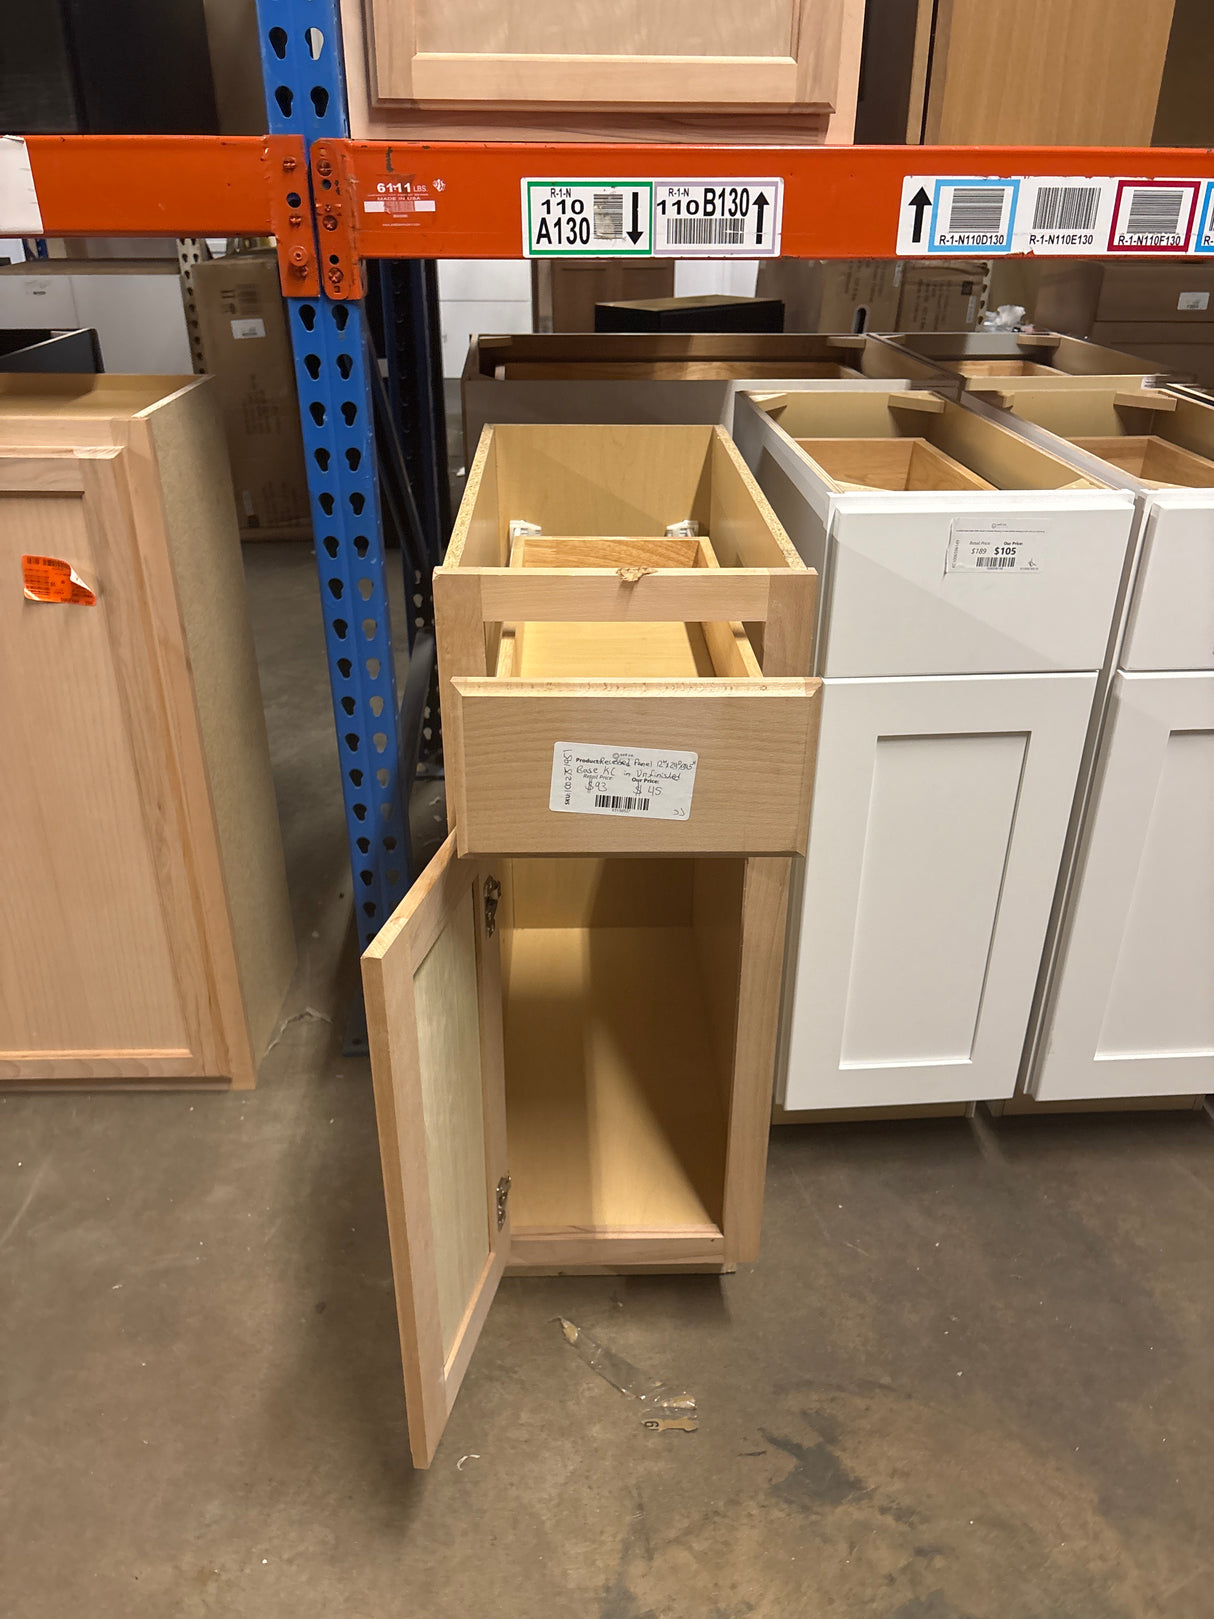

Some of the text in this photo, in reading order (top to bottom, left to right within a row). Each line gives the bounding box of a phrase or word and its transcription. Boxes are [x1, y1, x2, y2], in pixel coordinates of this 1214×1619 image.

[550, 188, 571, 198] R-1-N
[668, 188, 689, 197] R-1-N
[541, 199, 584, 215] 110
[657, 188, 749, 217] 110 B130
[536, 217, 590, 245] A130
[939, 235, 1005, 245] R-1-N110D130
[1029, 235, 1094, 245] R-1-N110E130
[1118, 235, 1181, 246] R-1-N110F130
[971, 547, 987, 555] $189
[994, 547, 1016, 556] $105
[634, 759, 653, 767] Panel
[576, 766, 598, 774] Base
